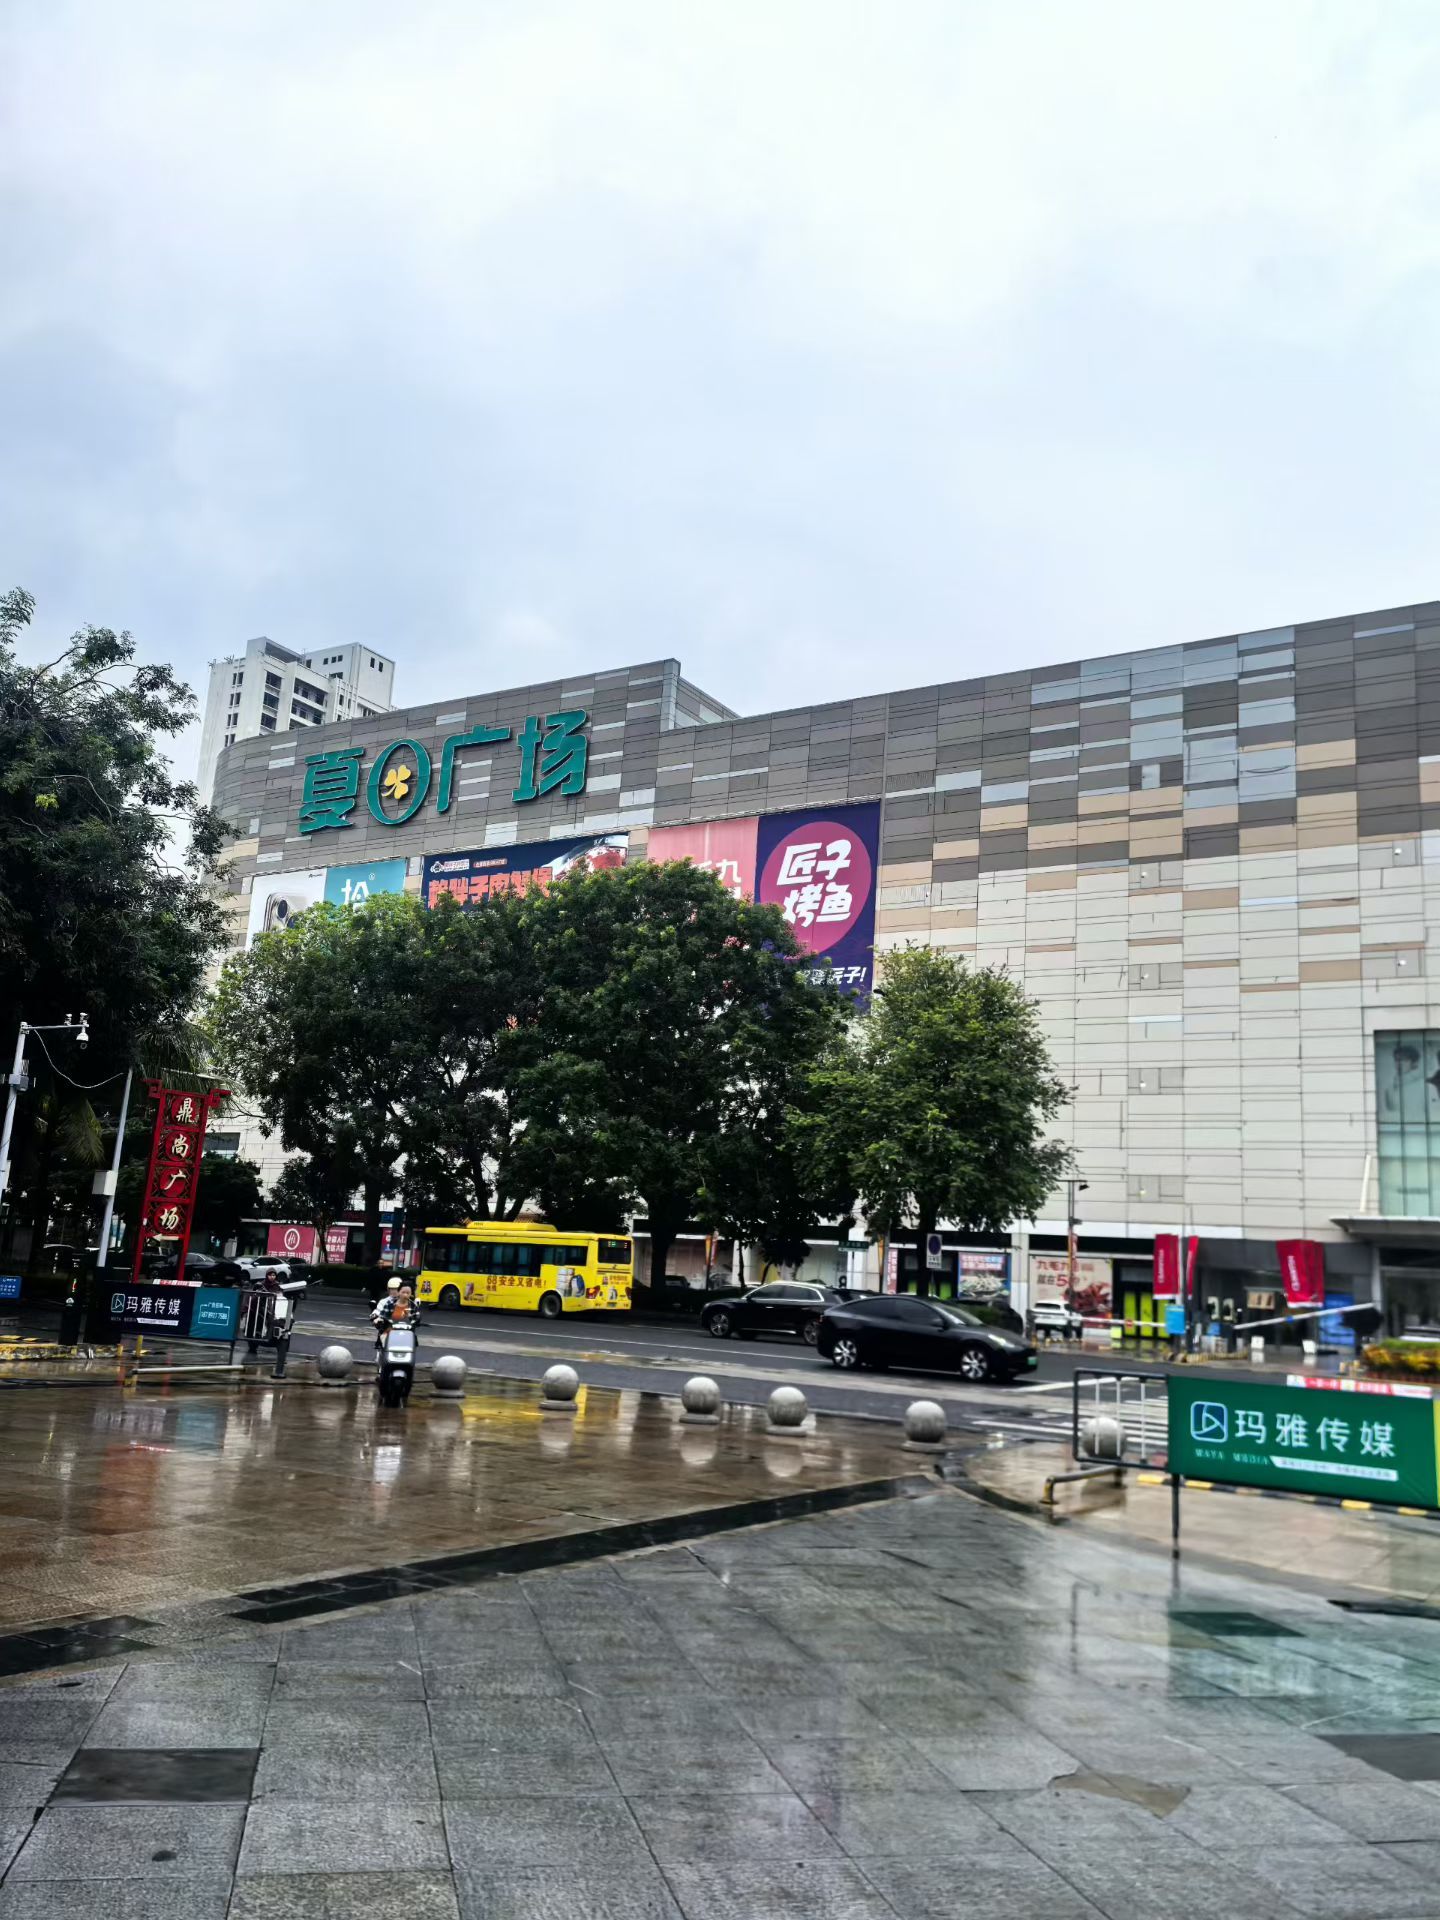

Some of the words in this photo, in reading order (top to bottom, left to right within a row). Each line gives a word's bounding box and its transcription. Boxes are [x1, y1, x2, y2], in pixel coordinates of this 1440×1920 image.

[776, 839, 852, 885] 匠子
[782, 882, 852, 928] 烤鱼
[160, 1097, 195, 1230] 鼎尚广场
[126, 1296, 181, 1316] 玛雅传媒
[1234, 1409, 1396, 1458] 玛雅传媒
